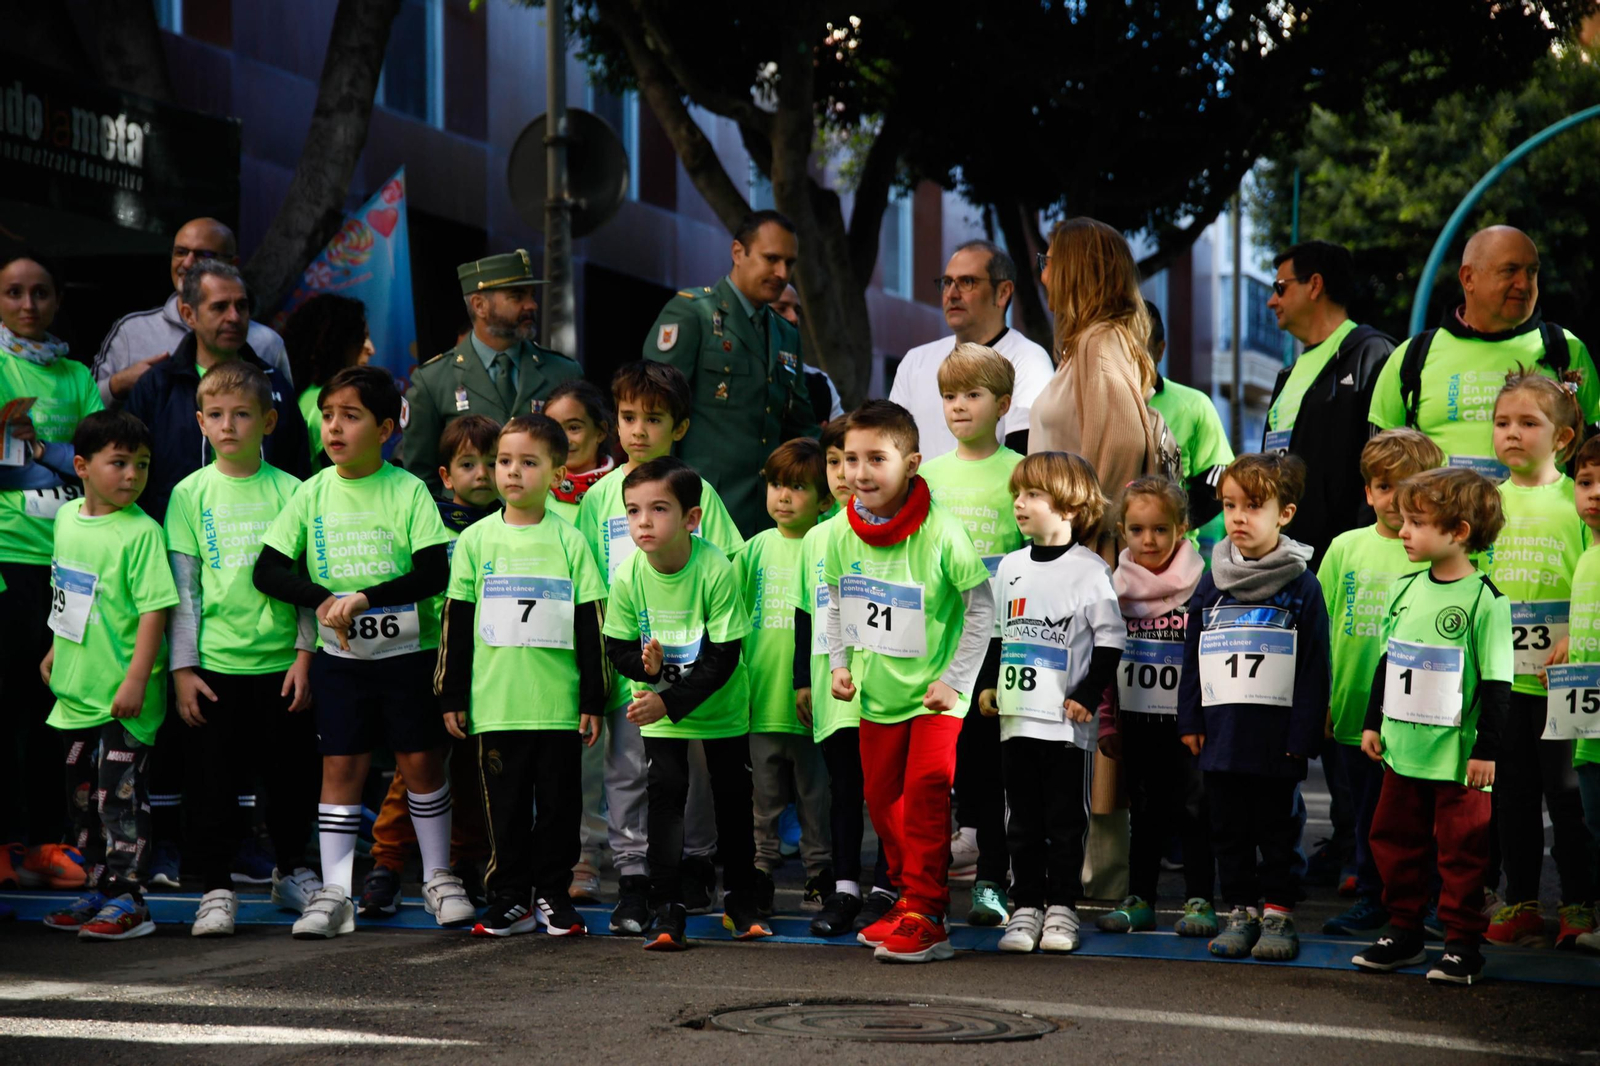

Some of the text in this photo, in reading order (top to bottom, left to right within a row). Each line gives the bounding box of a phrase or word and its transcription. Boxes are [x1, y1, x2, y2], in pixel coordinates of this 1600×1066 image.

[0, 80, 143, 168] dolameta
[218, 521, 237, 533] En
[327, 527, 395, 543] En marcha
[981, 521, 996, 534] el
[202, 507, 221, 569] ALMERÍA
[313, 515, 330, 580] ALMERÍA
[1514, 533, 1566, 551] marcha
[224, 548, 260, 568] cán
[329, 541, 394, 558] contra el
[1495, 548, 1562, 567] contra el
[843, 578, 866, 586] Almería
[1495, 562, 1561, 587] cáncer
[765, 583, 779, 594] En
[1357, 587, 1373, 600] En
[517, 599, 537, 623] 7
[1343, 570, 1356, 637] ALMERÍA
[1356, 603, 1384, 616] con
[763, 610, 795, 630] cán
[866, 602, 892, 631] 21
[1040, 628, 1066, 645] CAR
[1129, 630, 1179, 639] SPORTSWEAR
[1203, 640, 1222, 648] contra
[1204, 633, 1226, 641] Almería
[1511, 625, 1552, 650] 23
[1225, 653, 1265, 678] 17
[1005, 665, 1037, 691] 98
[1124, 663, 1178, 690] 100
[1399, 668, 1413, 695] 1
[1565, 688, 1600, 714] 15
[106, 750, 135, 762] MARVEL
